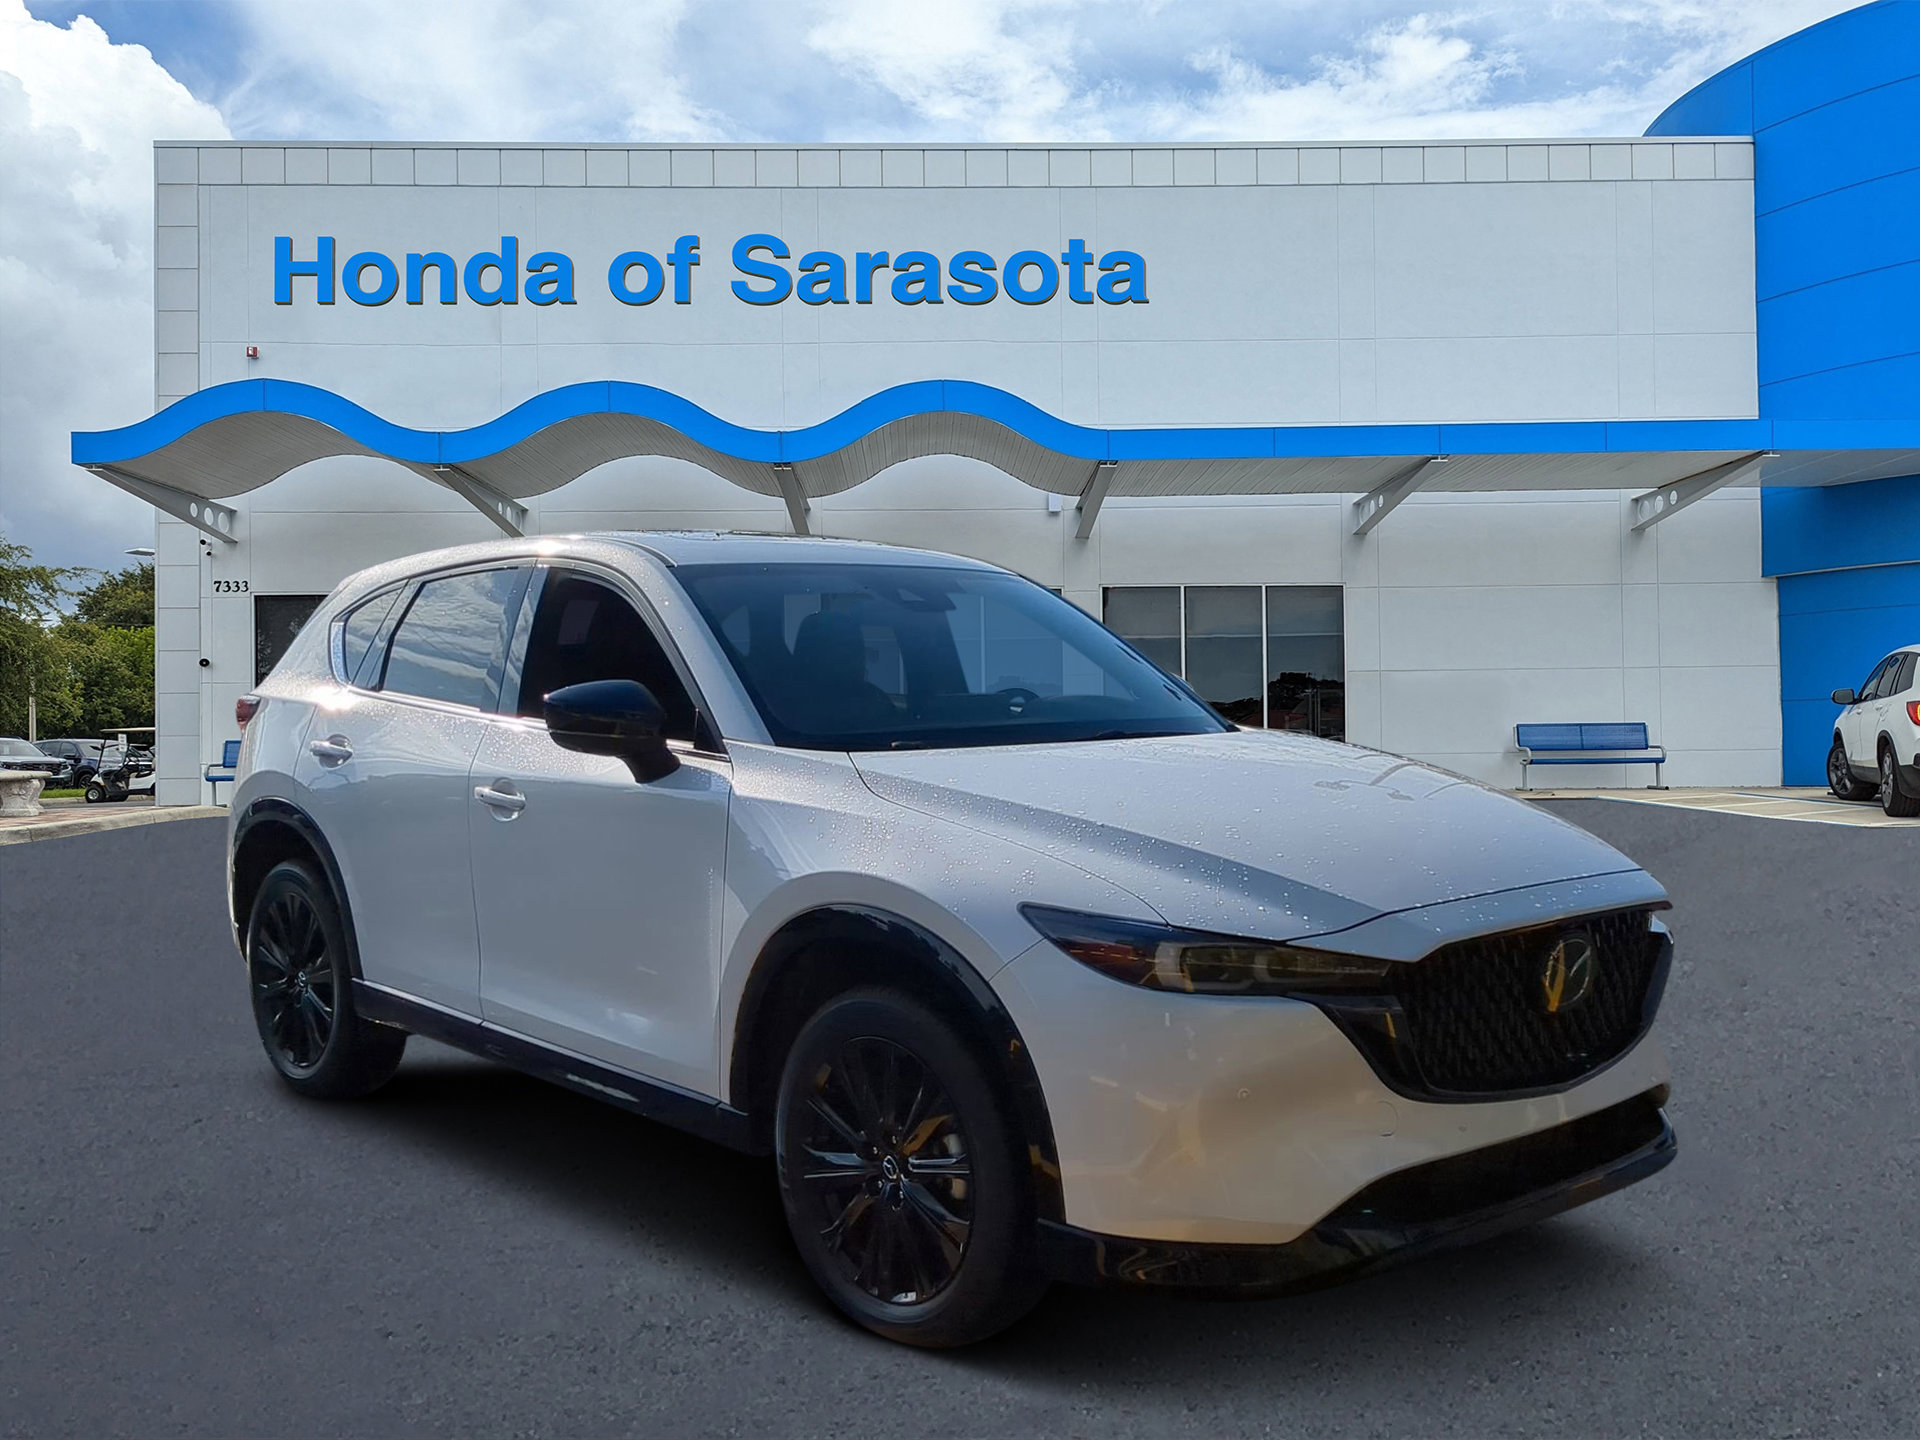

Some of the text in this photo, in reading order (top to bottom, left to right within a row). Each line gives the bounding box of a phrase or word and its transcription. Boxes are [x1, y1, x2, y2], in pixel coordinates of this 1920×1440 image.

[273, 233, 1150, 306] Honda of Sarasota
[213, 580, 249, 593] 7333
